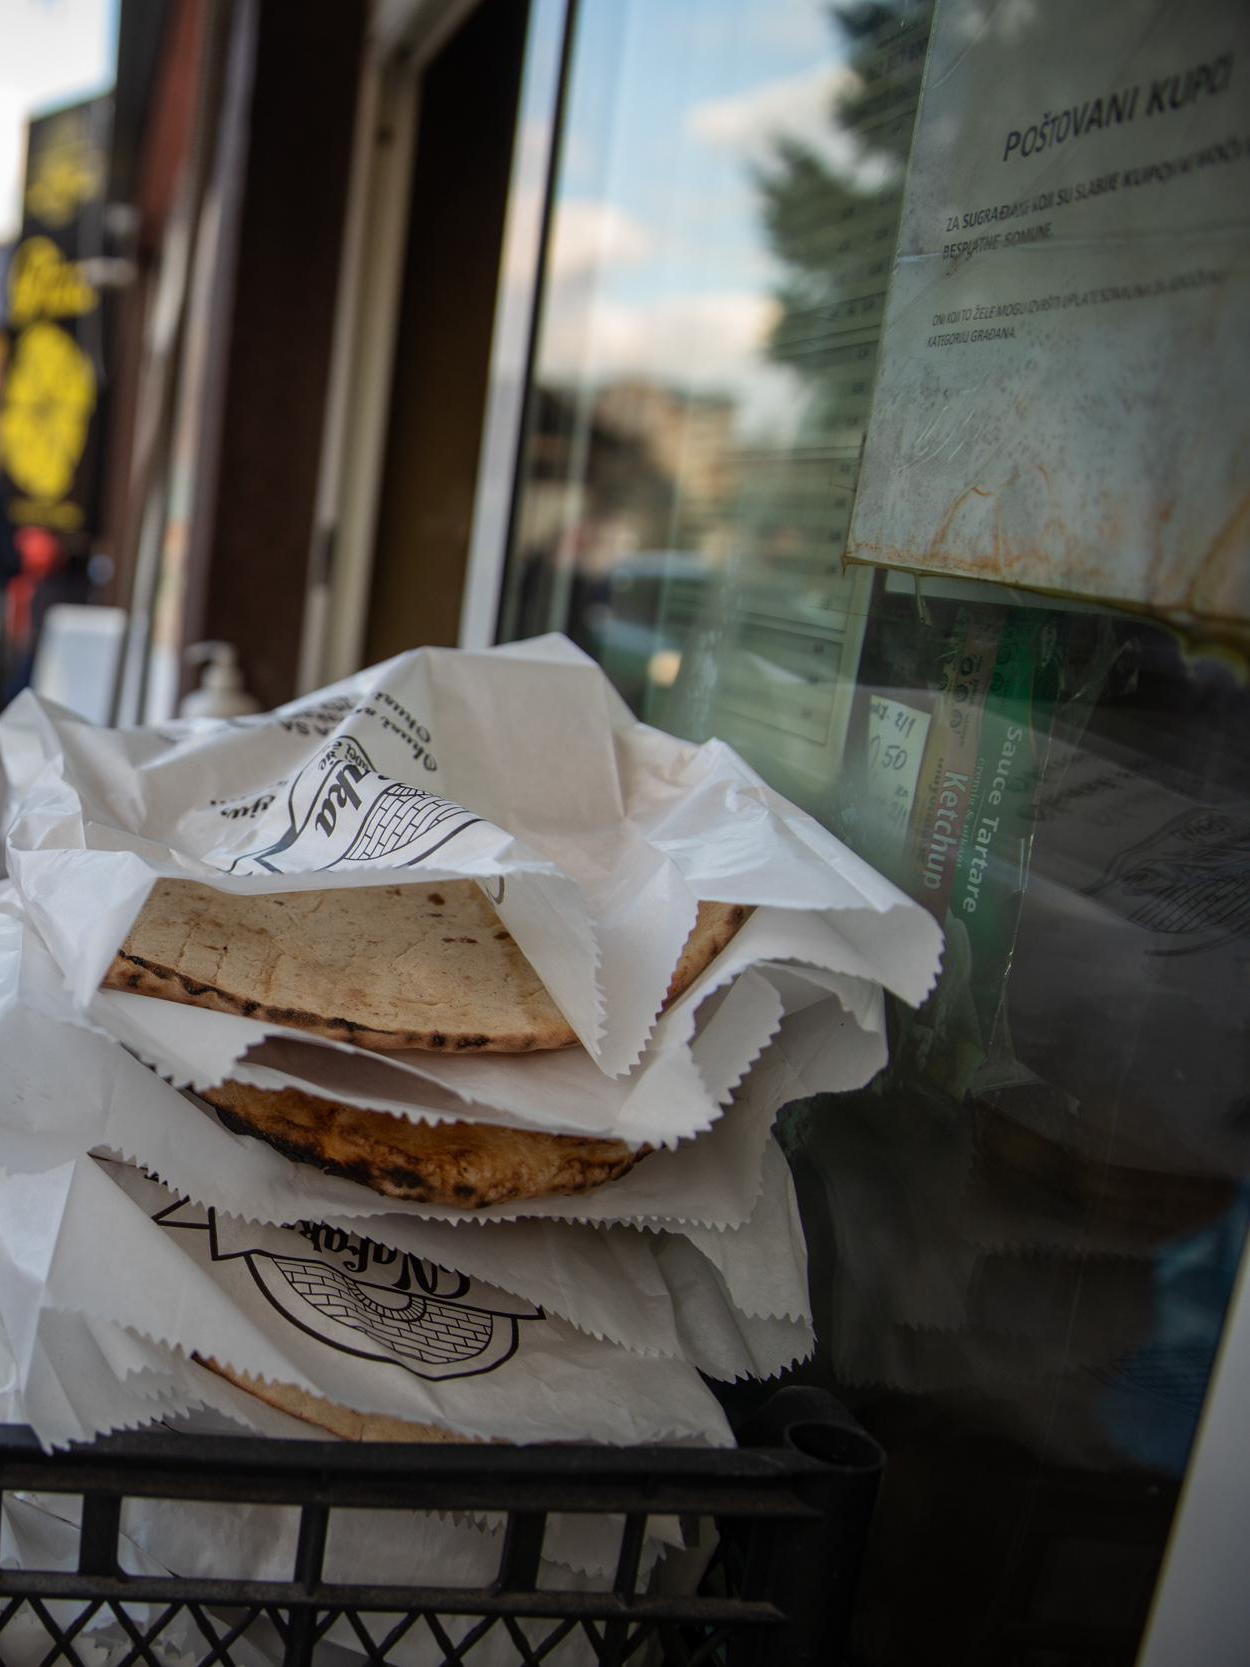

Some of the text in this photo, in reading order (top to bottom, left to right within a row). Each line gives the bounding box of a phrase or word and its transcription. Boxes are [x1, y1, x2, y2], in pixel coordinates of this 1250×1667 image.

[1003, 86, 1139, 162] POŠTOVANI
[946, 215, 959, 232] ZA
[1056, 186, 1073, 206] SU
[943, 234, 1001, 259] BESPLATNE
[932, 313, 946, 326] ONI
[946, 310, 961, 324] KOJI
[961, 308, 972, 321] TO
[973, 304, 996, 320] ŽELE
[996, 301, 1028, 318] MOGU
[927, 330, 969, 347] KATEGORIJU
[923, 769, 969, 890] Ketchup
[962, 725, 1023, 913] Sauce Tartare
